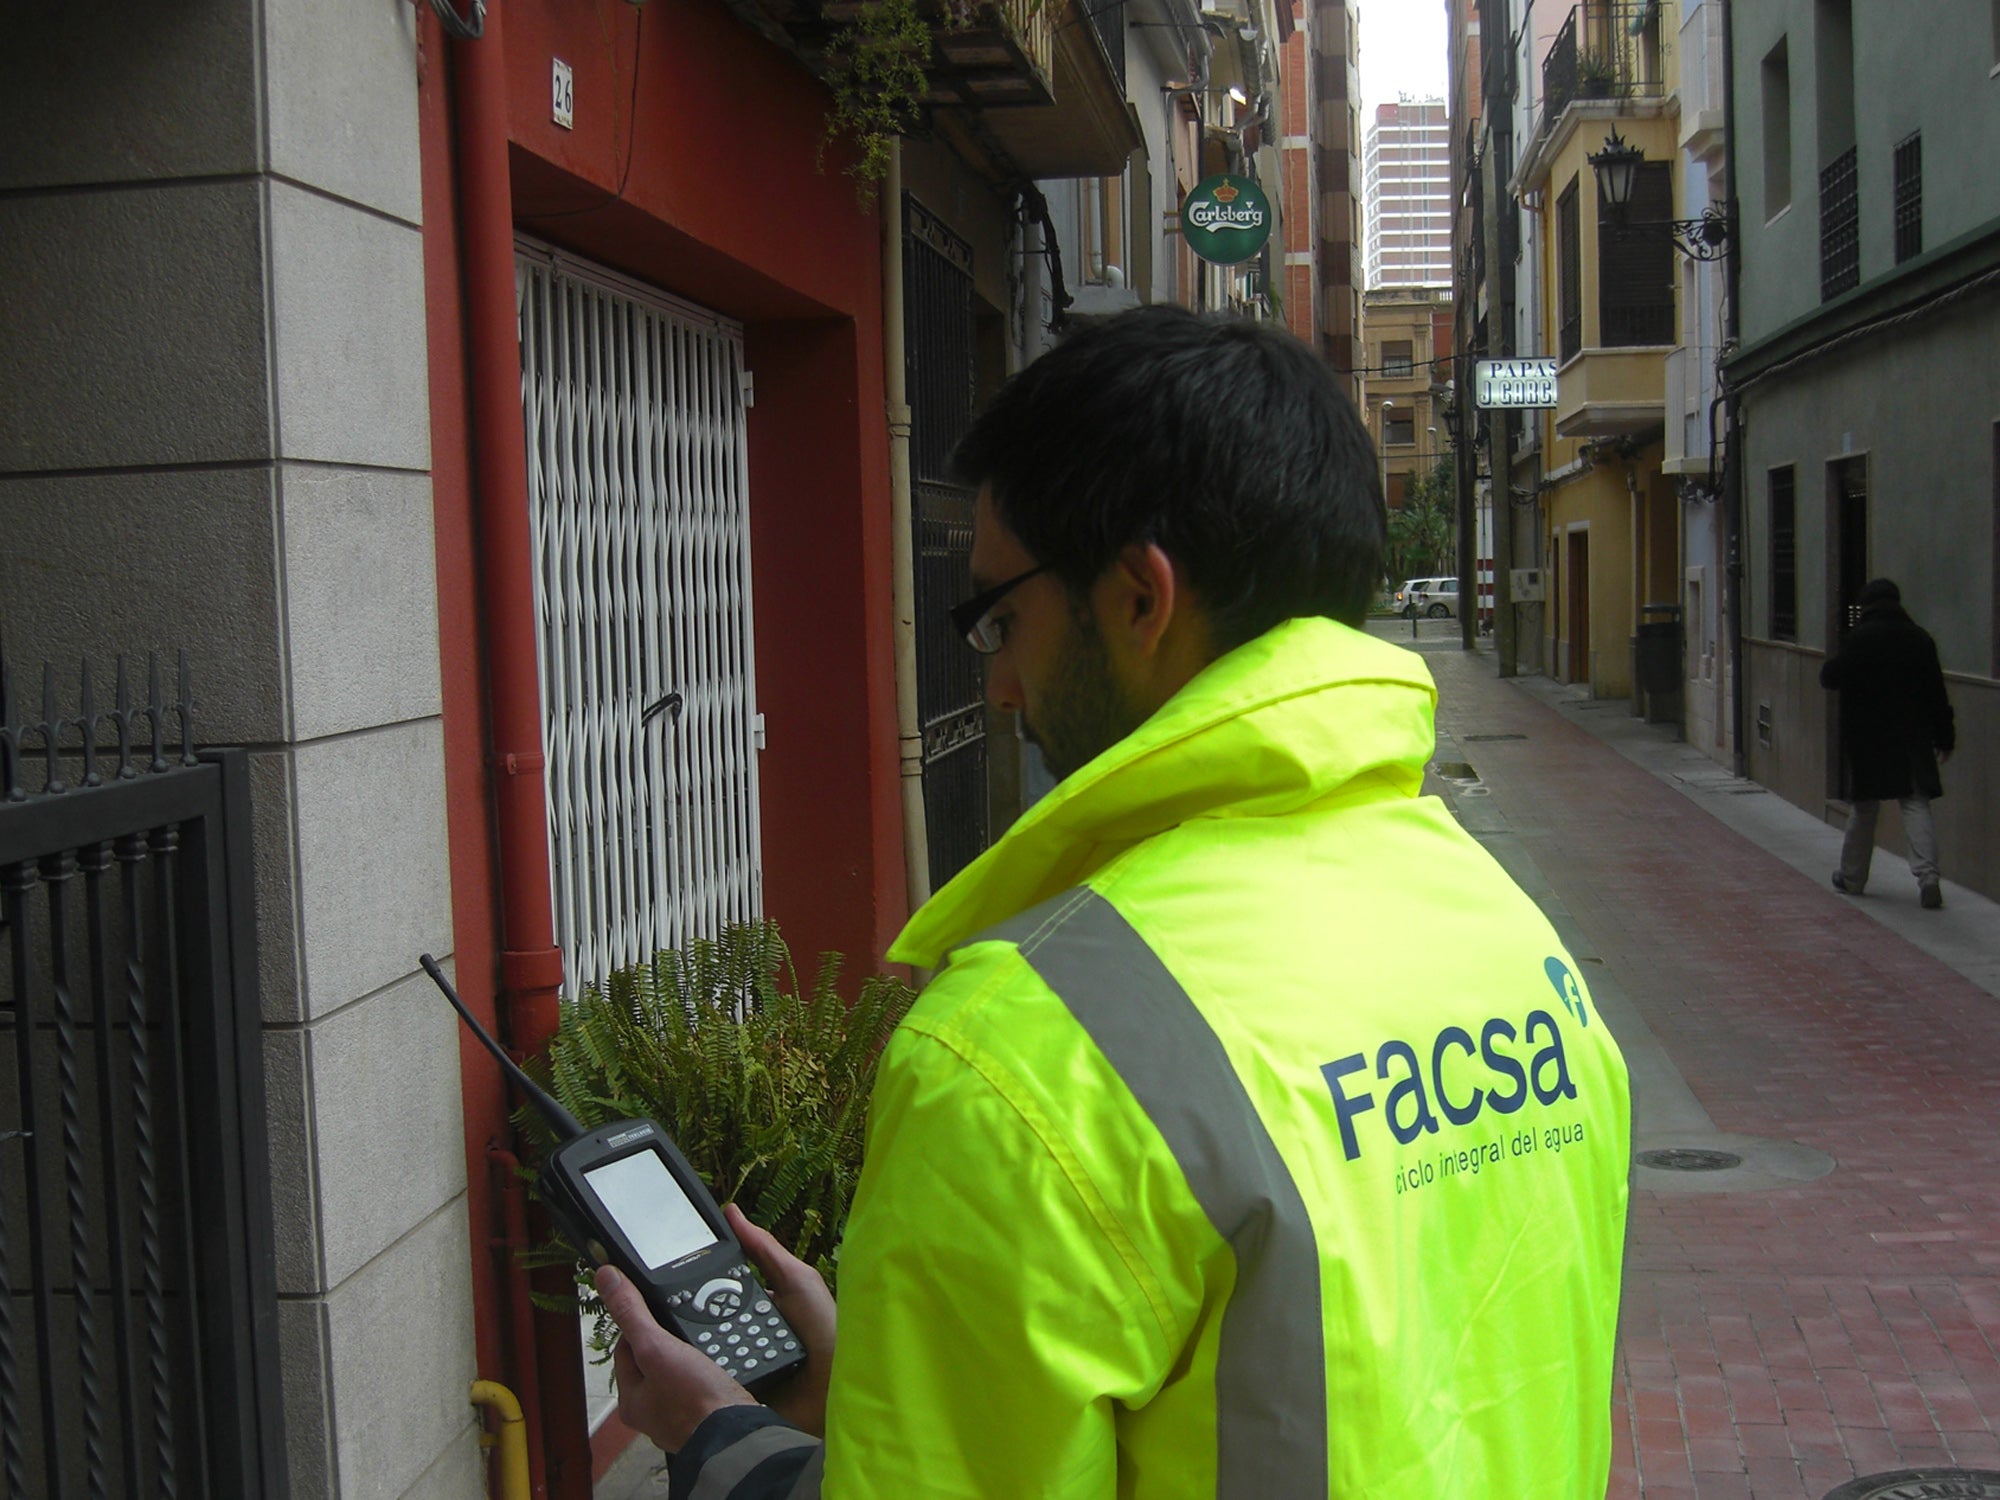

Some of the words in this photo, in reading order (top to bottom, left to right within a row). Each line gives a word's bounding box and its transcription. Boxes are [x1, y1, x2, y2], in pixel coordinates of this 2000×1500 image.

[555, 75, 572, 113] 26
[1188, 201, 1263, 228] Carlsberg
[1490, 361, 1557, 378] PAPAS
[1396, 1160, 1434, 1194] ciclo
[1439, 1135, 1506, 1175] integral
[1511, 1127, 1538, 1156] del
[1545, 1123, 1584, 1153] agua
